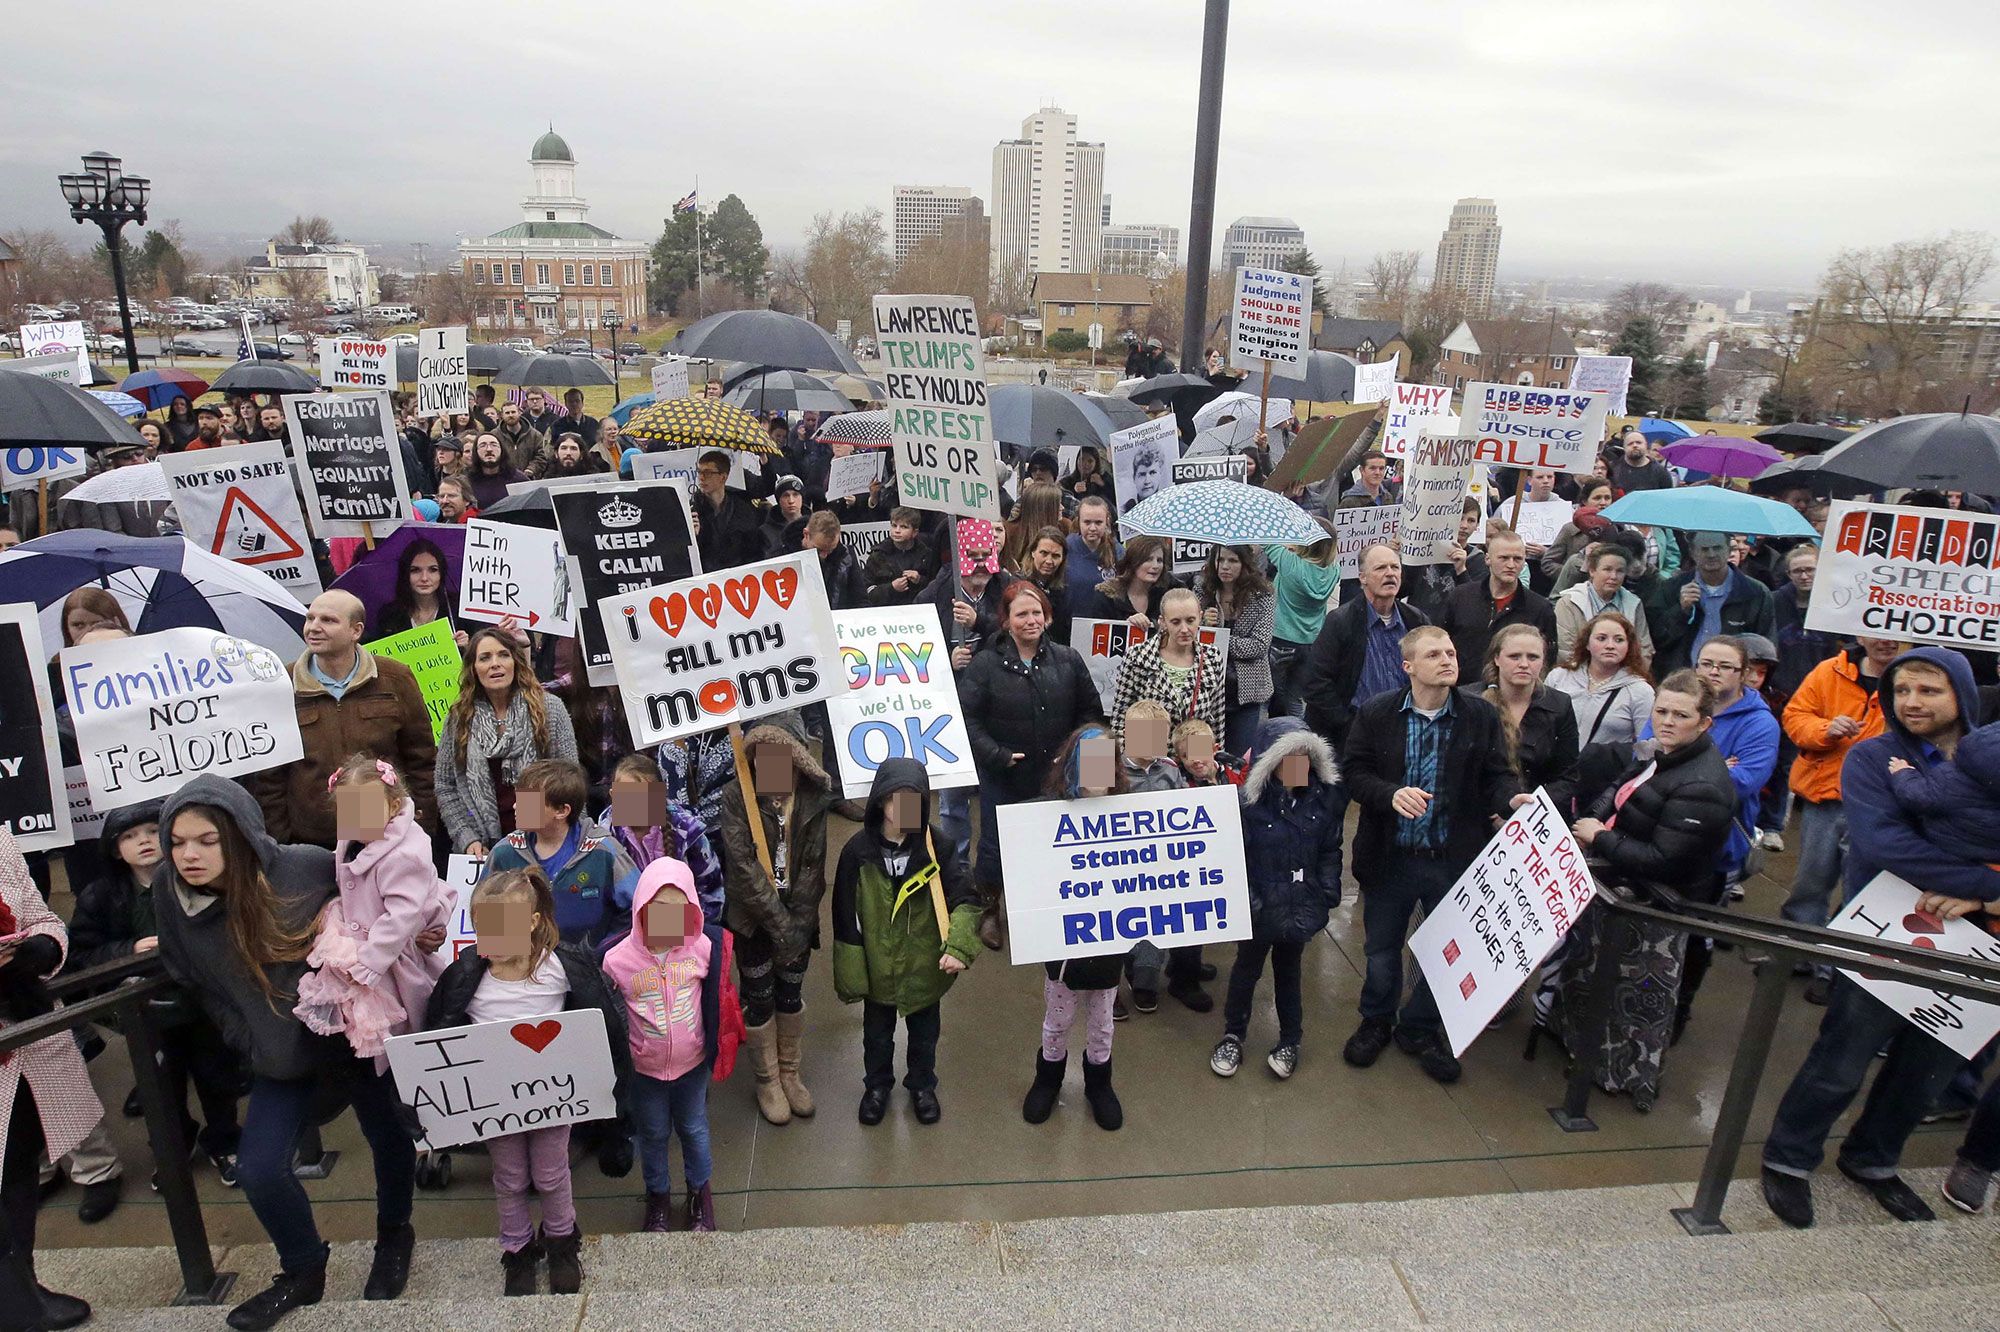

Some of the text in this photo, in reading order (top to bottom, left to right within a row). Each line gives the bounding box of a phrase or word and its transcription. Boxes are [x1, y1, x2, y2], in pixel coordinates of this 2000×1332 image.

[1244, 270, 1300, 287] Laws &
[1242, 284, 1301, 302] Judgment
[1240, 310, 1300, 328] THE SAME
[1241, 298, 1301, 315] SHOULD BE
[876, 306, 977, 336] LAWRENCE
[1239, 322, 1299, 339] Regardless of
[342, 343, 386, 356] LOVE
[437, 331, 446, 350] I
[1239, 333, 1298, 350] Religion
[362, 359, 379, 370] my
[881, 340, 975, 371] TRUMPS
[1238, 346, 1297, 362] or Race
[419, 356, 465, 379] CHOOSE
[419, 381, 468, 412] POLYGAMY
[886, 373, 987, 407] REYNOLDS
[1397, 386, 1447, 407] WHY
[296, 399, 378, 420] EQUALITY
[1408, 406, 1430, 416] is it
[1485, 388, 1592, 419] LIBERTY
[332, 420, 347, 430] in
[893, 408, 985, 441] ARREST
[1481, 411, 1508, 423] AND
[304, 434, 386, 454] Marriage
[1113, 429, 1176, 453] Martha Hughes Cannon
[1127, 422, 1162, 441] Polygamist
[907, 441, 938, 468] US
[947, 446, 981, 476] OR
[1473, 437, 1567, 469] ALL
[1554, 441, 1580, 452] FOR
[6, 447, 77, 475] OK
[312, 465, 392, 483] EQUALITY
[1175, 462, 1245, 480] EQUALITY
[173, 461, 286, 490] NOT SO SAFE
[347, 483, 362, 494] in
[1422, 471, 1465, 502] minority
[902, 472, 995, 509] SHUT UP!
[318, 493, 401, 519] Family
[1336, 510, 1355, 526] If
[1360, 509, 1371, 523] I
[1374, 509, 1390, 522] like
[1427, 500, 1463, 516] correct
[470, 525, 508, 552] I'm
[594, 530, 656, 551] KEEP
[1346, 526, 1376, 539] should
[1381, 520, 1400, 534] BE
[1840, 520, 2000, 564] FREEDO
[1401, 541, 1434, 557] ainst.
[263, 565, 302, 581] BOR
[599, 555, 664, 576] CALM
[468, 578, 520, 608] HER
[617, 577, 653, 595] and
[655, 573, 795, 634] LOVE
[836, 623, 926, 640] f we were
[1862, 607, 1997, 642] CHOICE
[593, 652, 611, 663] an
[664, 621, 786, 675] ALL my
[840, 641, 934, 690] GAY
[69, 651, 235, 715] Families
[149, 694, 219, 731] NOT
[859, 694, 932, 717] we'd be
[848, 714, 960, 771] OK
[95, 721, 276, 793] Felons
[19, 812, 53, 831] ON
[71, 811, 105, 823] ular
[1054, 805, 1215, 843] AMERICA
[1070, 844, 1158, 870] stand
[1527, 794, 1591, 913] The POWER
[1059, 867, 1224, 899] for what is
[1505, 820, 1570, 938] OF THE PEOPLE
[1472, 863, 1496, 906] than
[1495, 900, 1512, 931] the
[1503, 867, 1544, 936] Stronger
[1062, 897, 1228, 946] RIGHT!
[1850, 904, 1891, 938] I
[1469, 904, 1506, 972] POWER
[414, 1034, 484, 1072] I
[413, 1073, 575, 1118] ALL my
[472, 1099, 590, 1137] moms
